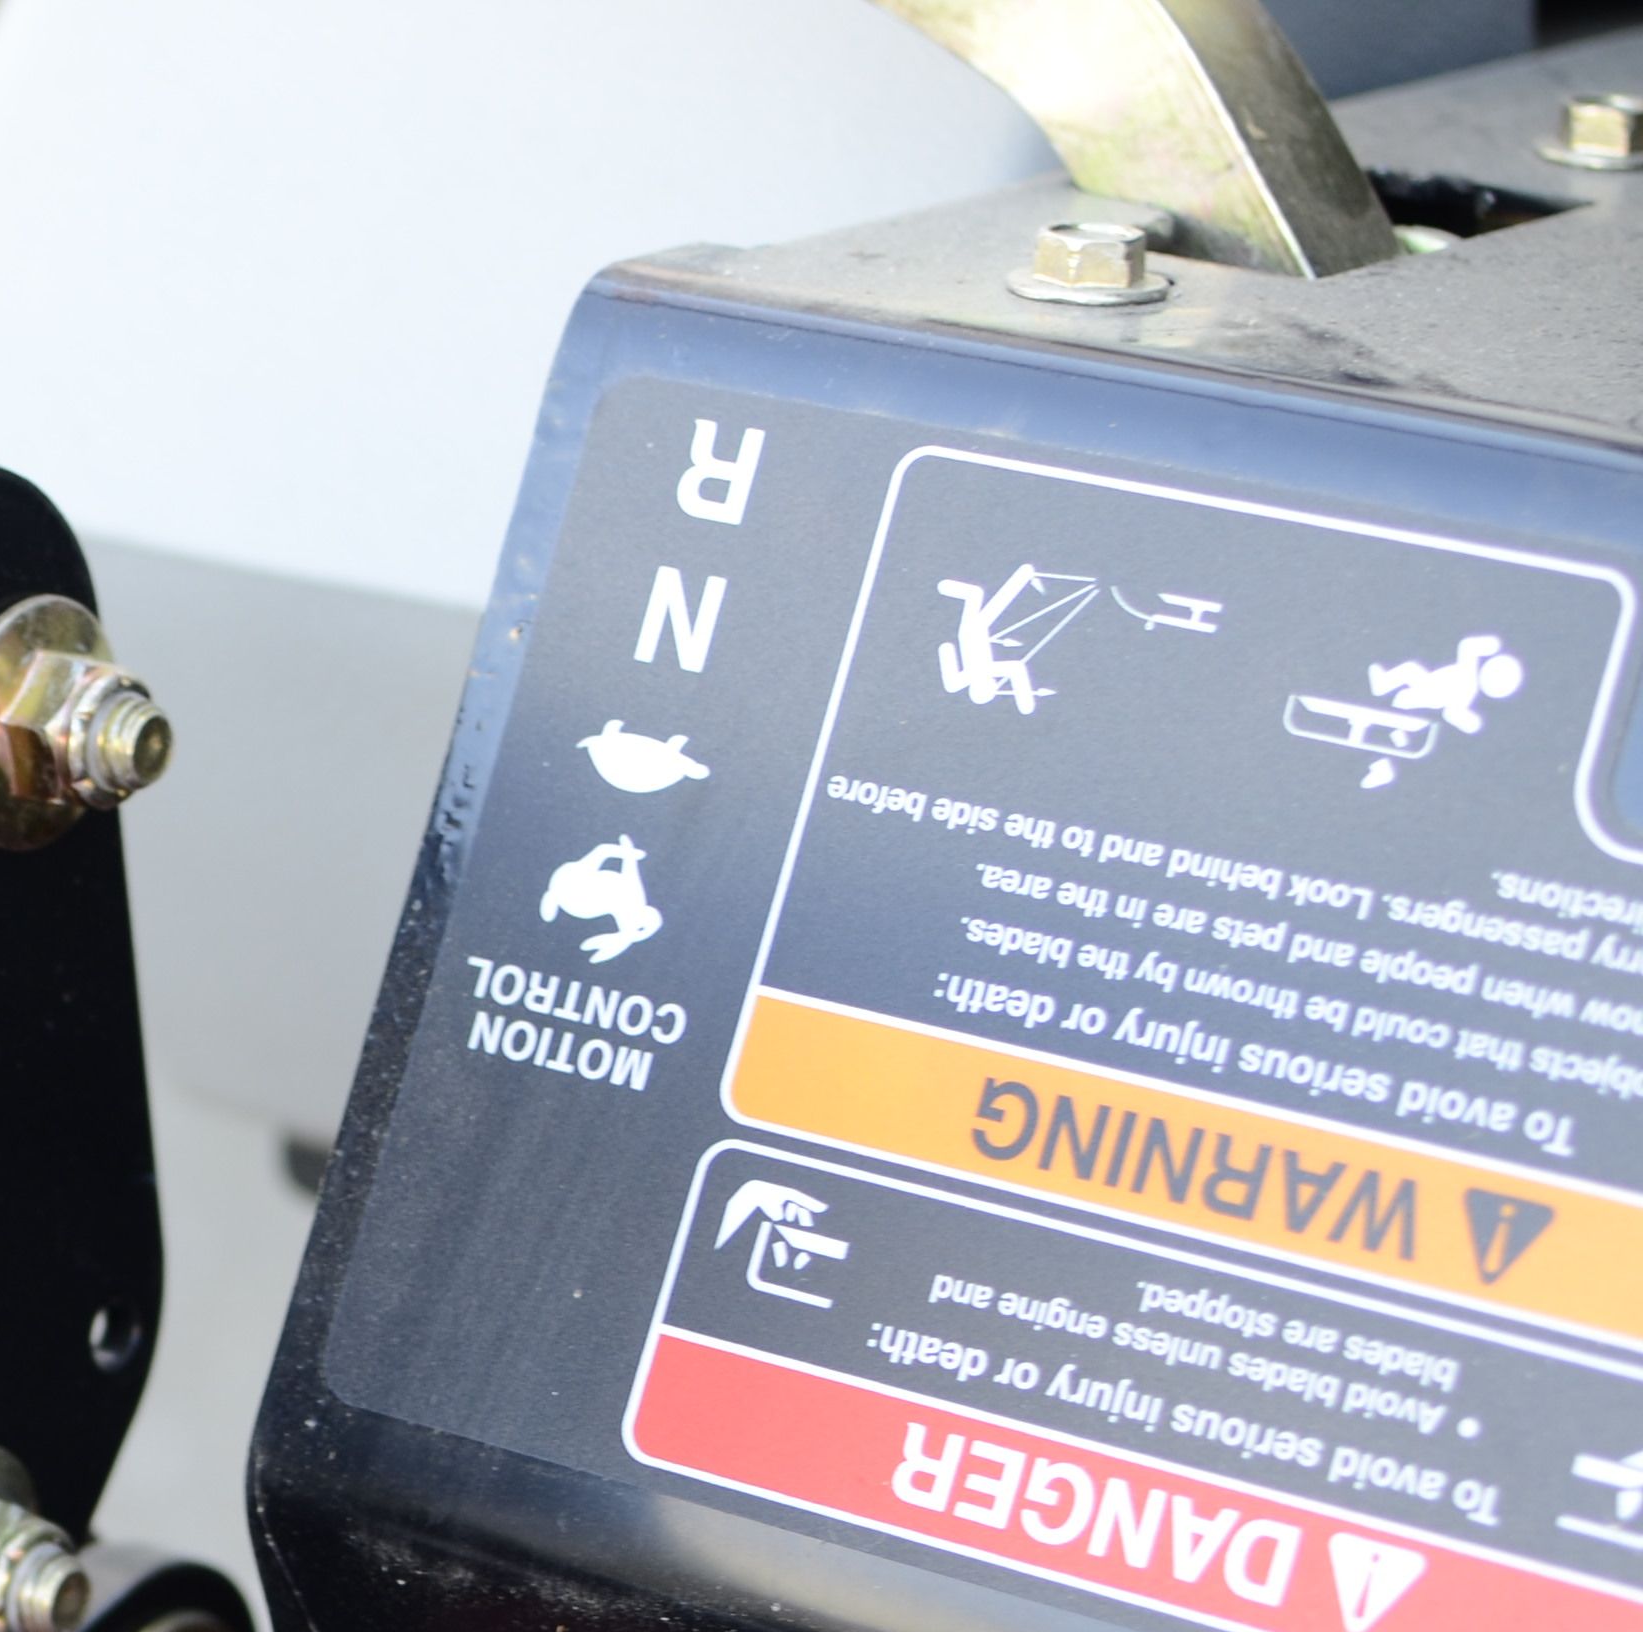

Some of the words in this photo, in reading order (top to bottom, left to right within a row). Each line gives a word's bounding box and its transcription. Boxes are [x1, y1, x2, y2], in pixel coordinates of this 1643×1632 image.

[676, 418, 766, 526] R
[633, 565, 728, 673] N
[827, 775, 928, 822] before
[931, 797, 1000, 835] side
[1003, 813, 1057, 849] the
[1061, 825, 1096, 858] to
[1098, 834, 1165, 867] and
[976, 863, 1053, 900] area.
[1165, 848, 1284, 900] behind
[1286, 874, 1374, 920] Look
[1056, 881, 1109, 918] the
[1114, 894, 1148, 929] in
[1152, 903, 1208, 934] are
[960, 917, 1074, 969] blades.
[1211, 916, 1288, 952] pets
[1287, 933, 1357, 968] and
[1382, 894, 1591, 961] passengers.
[1077, 944, 1130, 981] the
[1133, 951, 1179, 993] by
[1359, 949, 1479, 995] people
[467, 956, 687, 1045] CONTROL
[933, 972, 1056, 1029] death:
[1183, 968, 1300, 1020] thrown
[1304, 995, 1350, 1032] be
[1481, 976, 1575, 1019] when
[1060, 1003, 1107, 1035] or
[1112, 1007, 1231, 1074] injury
[1351, 1007, 1452, 1049] could
[467, 1011, 654, 1091] MOTION
[1238, 1043, 1392, 1103] serious
[1453, 1029, 1524, 1071] that
[1396, 1081, 1518, 1132] avoid
[1523, 1110, 1573, 1157] To
[970, 1077, 1416, 1261] WARNING
[928, 1274, 994, 1309] and
[1136, 1281, 1279, 1338] stopped.
[997, 1292, 1108, 1339] engine
[1282, 1319, 1340, 1353] are
[866, 1322, 989, 1382] death:
[1112, 1322, 1223, 1370] unless
[1343, 1335, 1459, 1392] blades
[993, 1358, 1040, 1390] or
[1227, 1352, 1341, 1408] blades
[1045, 1363, 1164, 1433] injury
[1342, 1382, 1447, 1434] Avoid
[1170, 1403, 1324, 1467] serious
[1327, 1446, 1447, 1501] avoid
[891, 1422, 1302, 1607] DANGER
[1452, 1479, 1498, 1526] To
